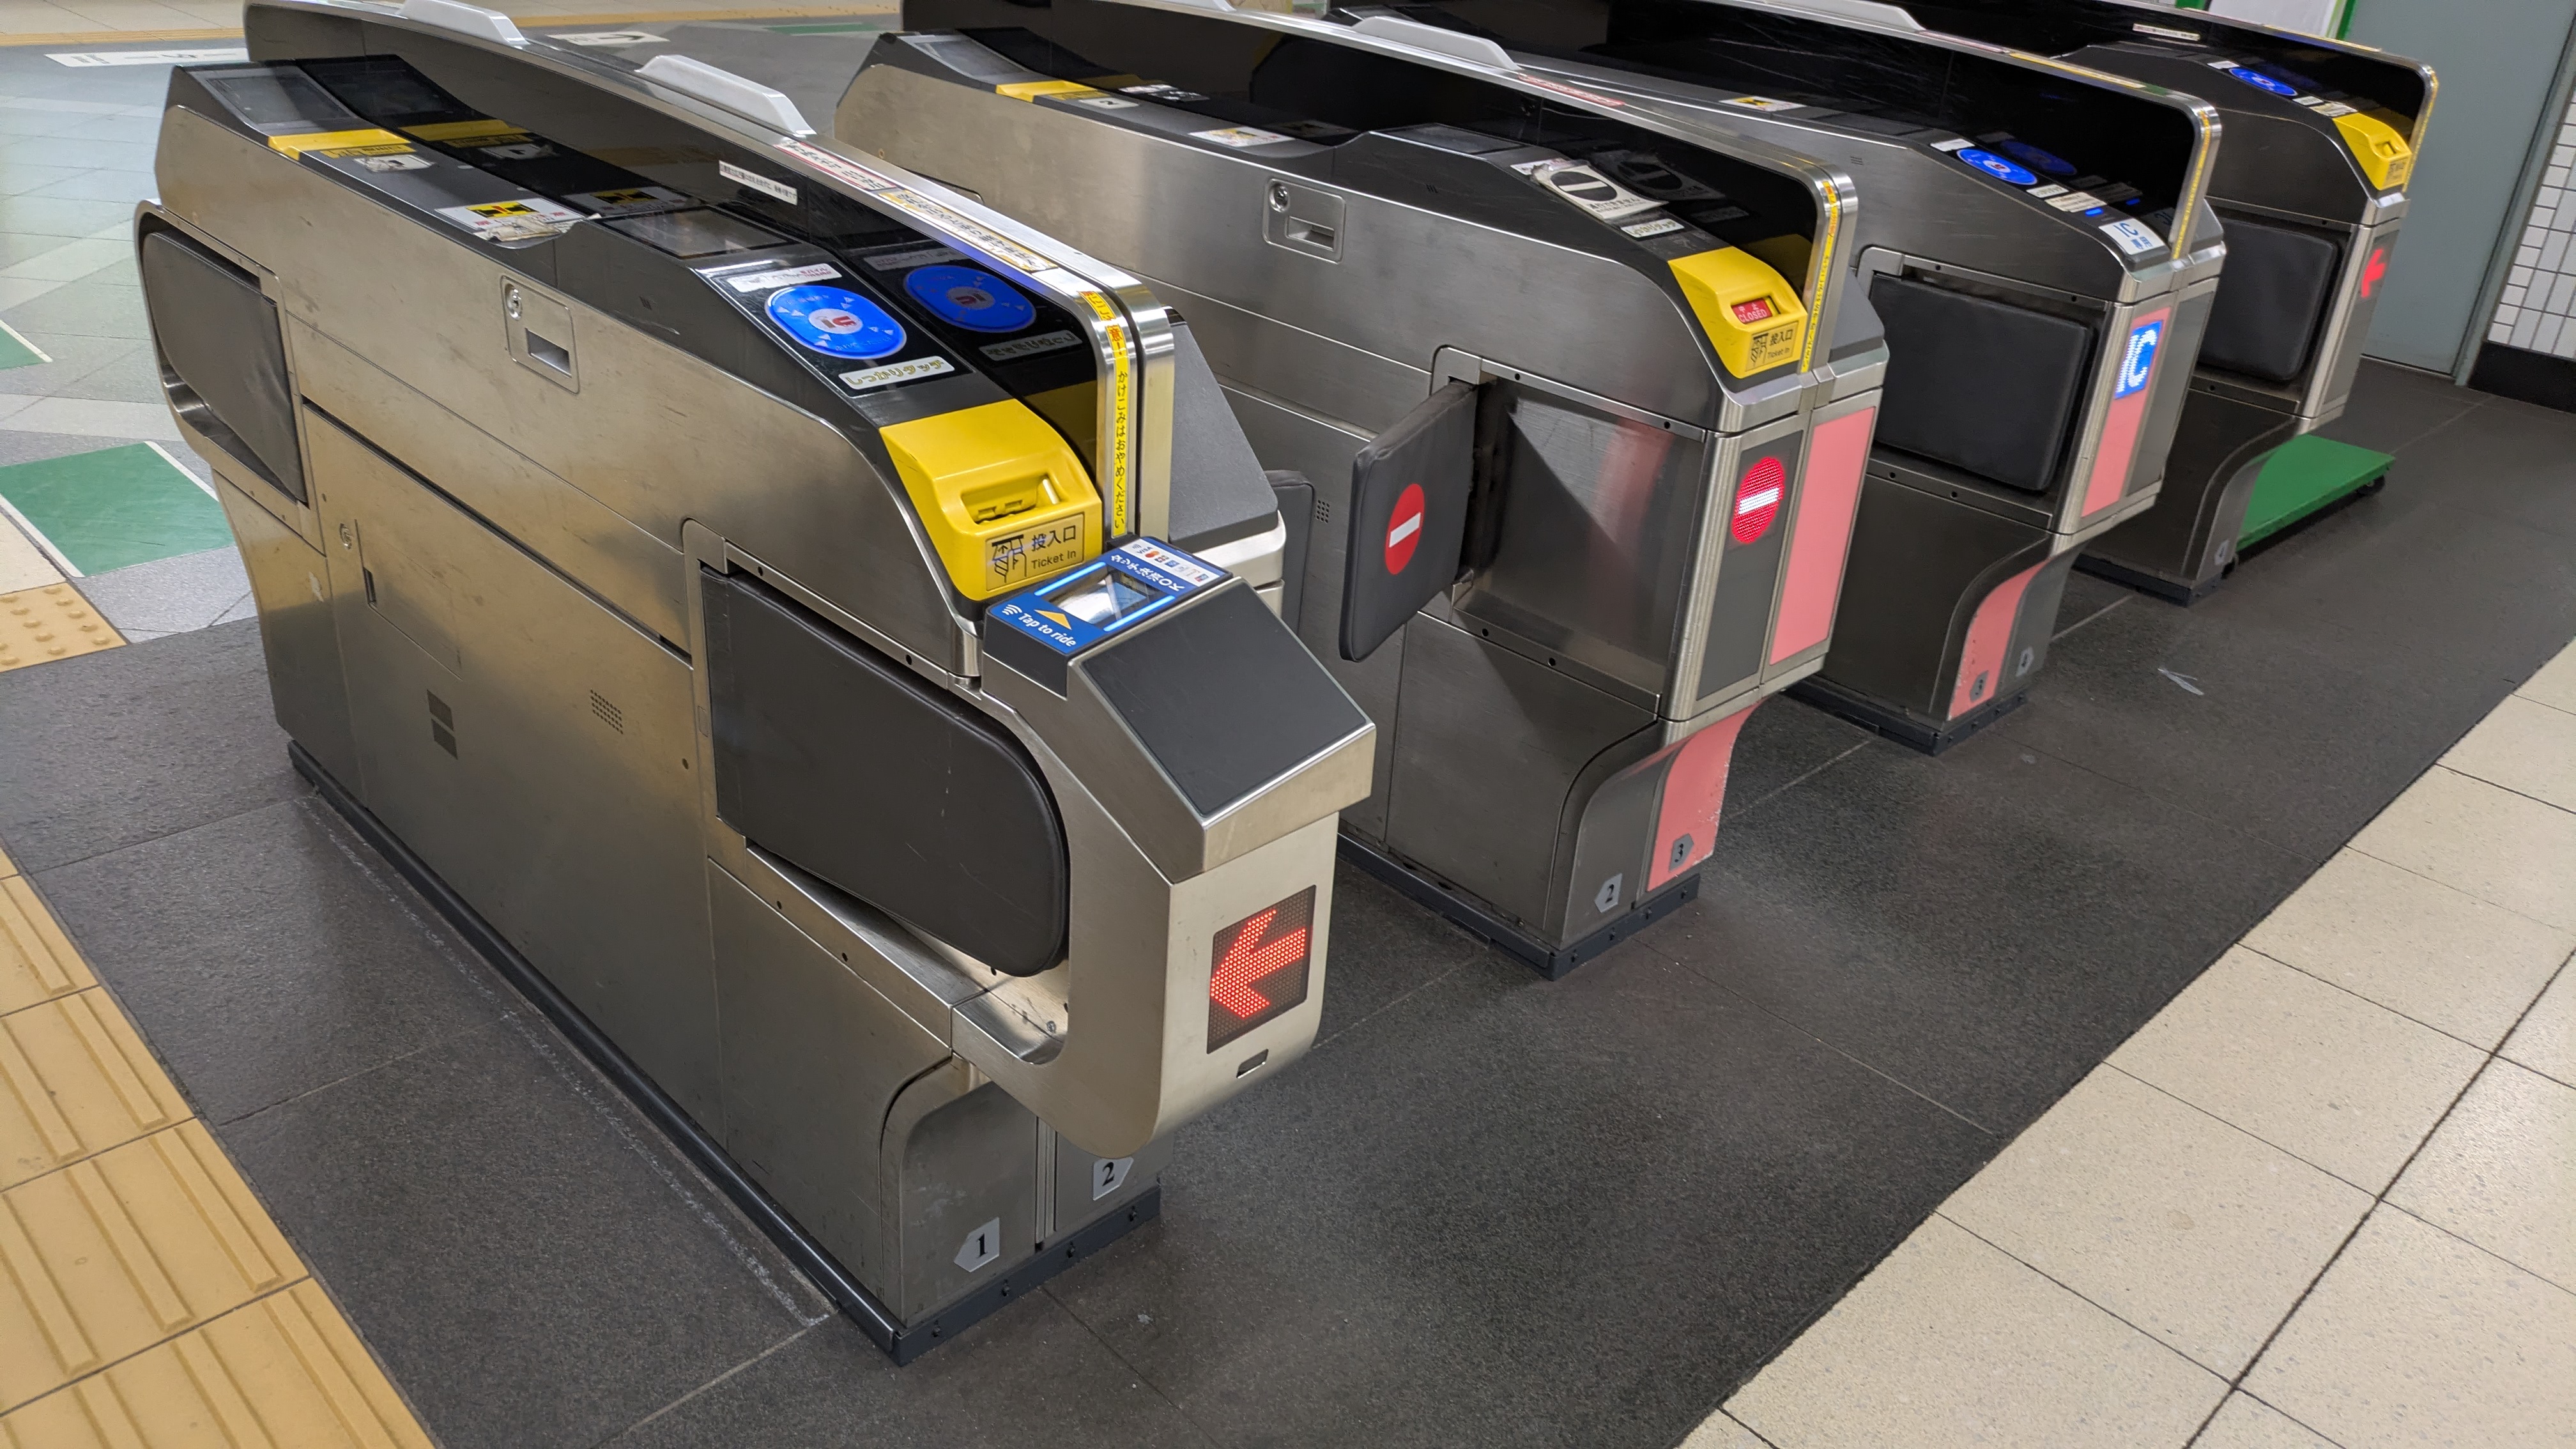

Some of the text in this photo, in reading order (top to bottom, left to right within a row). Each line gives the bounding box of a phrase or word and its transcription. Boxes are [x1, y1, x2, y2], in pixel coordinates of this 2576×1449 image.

[2113, 222, 2139, 238] IC
[1738, 309, 1768, 322] CLOSED
[1769, 329, 1793, 346] 投入口
[845, 359, 944, 385] しっかりタッチ
[1114, 371, 1128, 529] かけこみはおやめください
[1031, 525, 1076, 552] 投入口
[1031, 550, 1077, 569] Ticket In
[1018, 613, 1077, 647] Tap to ride
[1674, 843, 1684, 862] 3
[1604, 884, 1614, 904] 2
[1102, 1162, 1115, 1186] 2
[976, 1233, 988, 1259] 1
